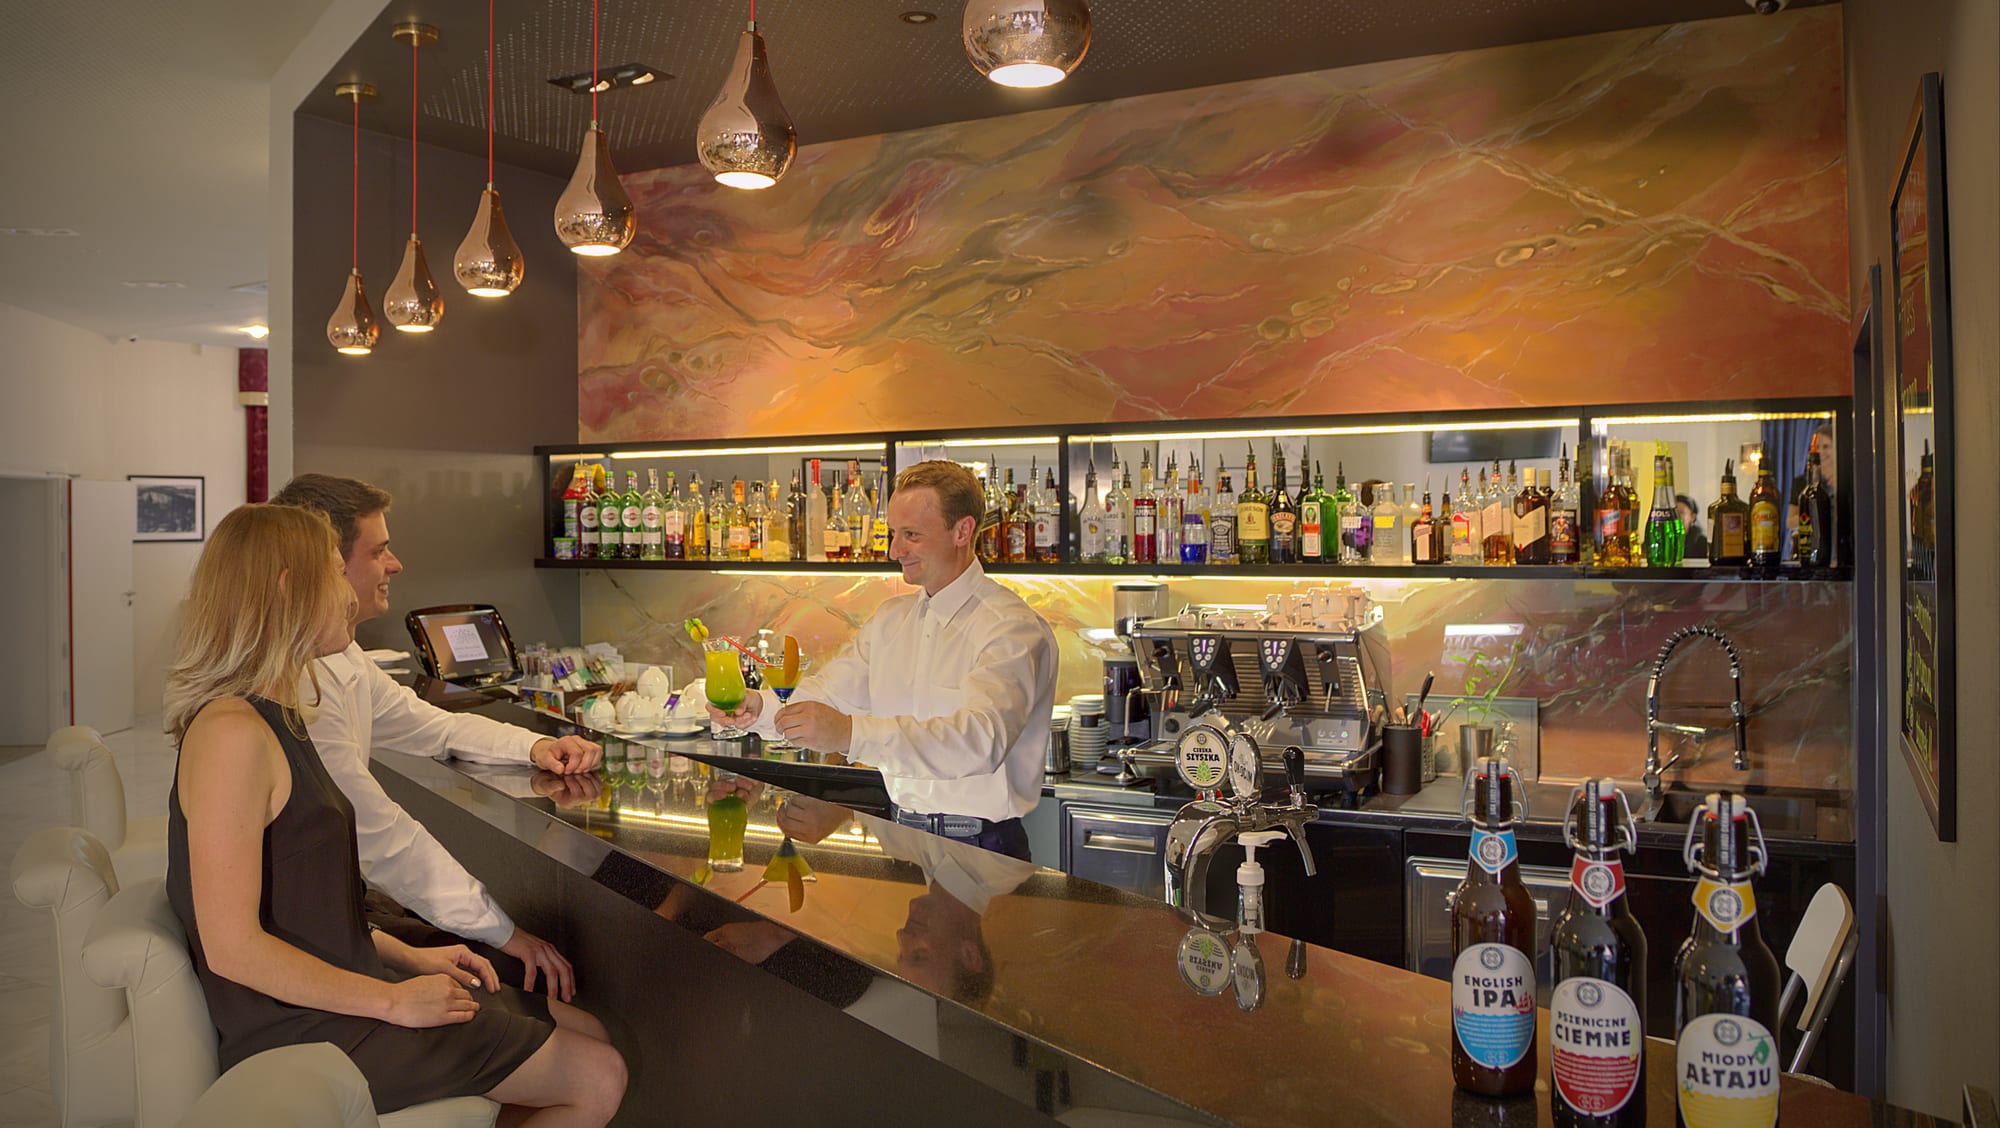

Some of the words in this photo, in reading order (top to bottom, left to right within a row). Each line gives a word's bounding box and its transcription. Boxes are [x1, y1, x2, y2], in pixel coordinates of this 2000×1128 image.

[1464, 975, 1523, 988] ENGLISH
[1473, 989, 1517, 1008] IPA
[1557, 1010, 1627, 1027] PSZENICZNE
[1555, 1024, 1631, 1048] CIEMNE
[1702, 1051, 1756, 1066] MIODY
[1686, 1062, 1771, 1089] AŁTAJU
